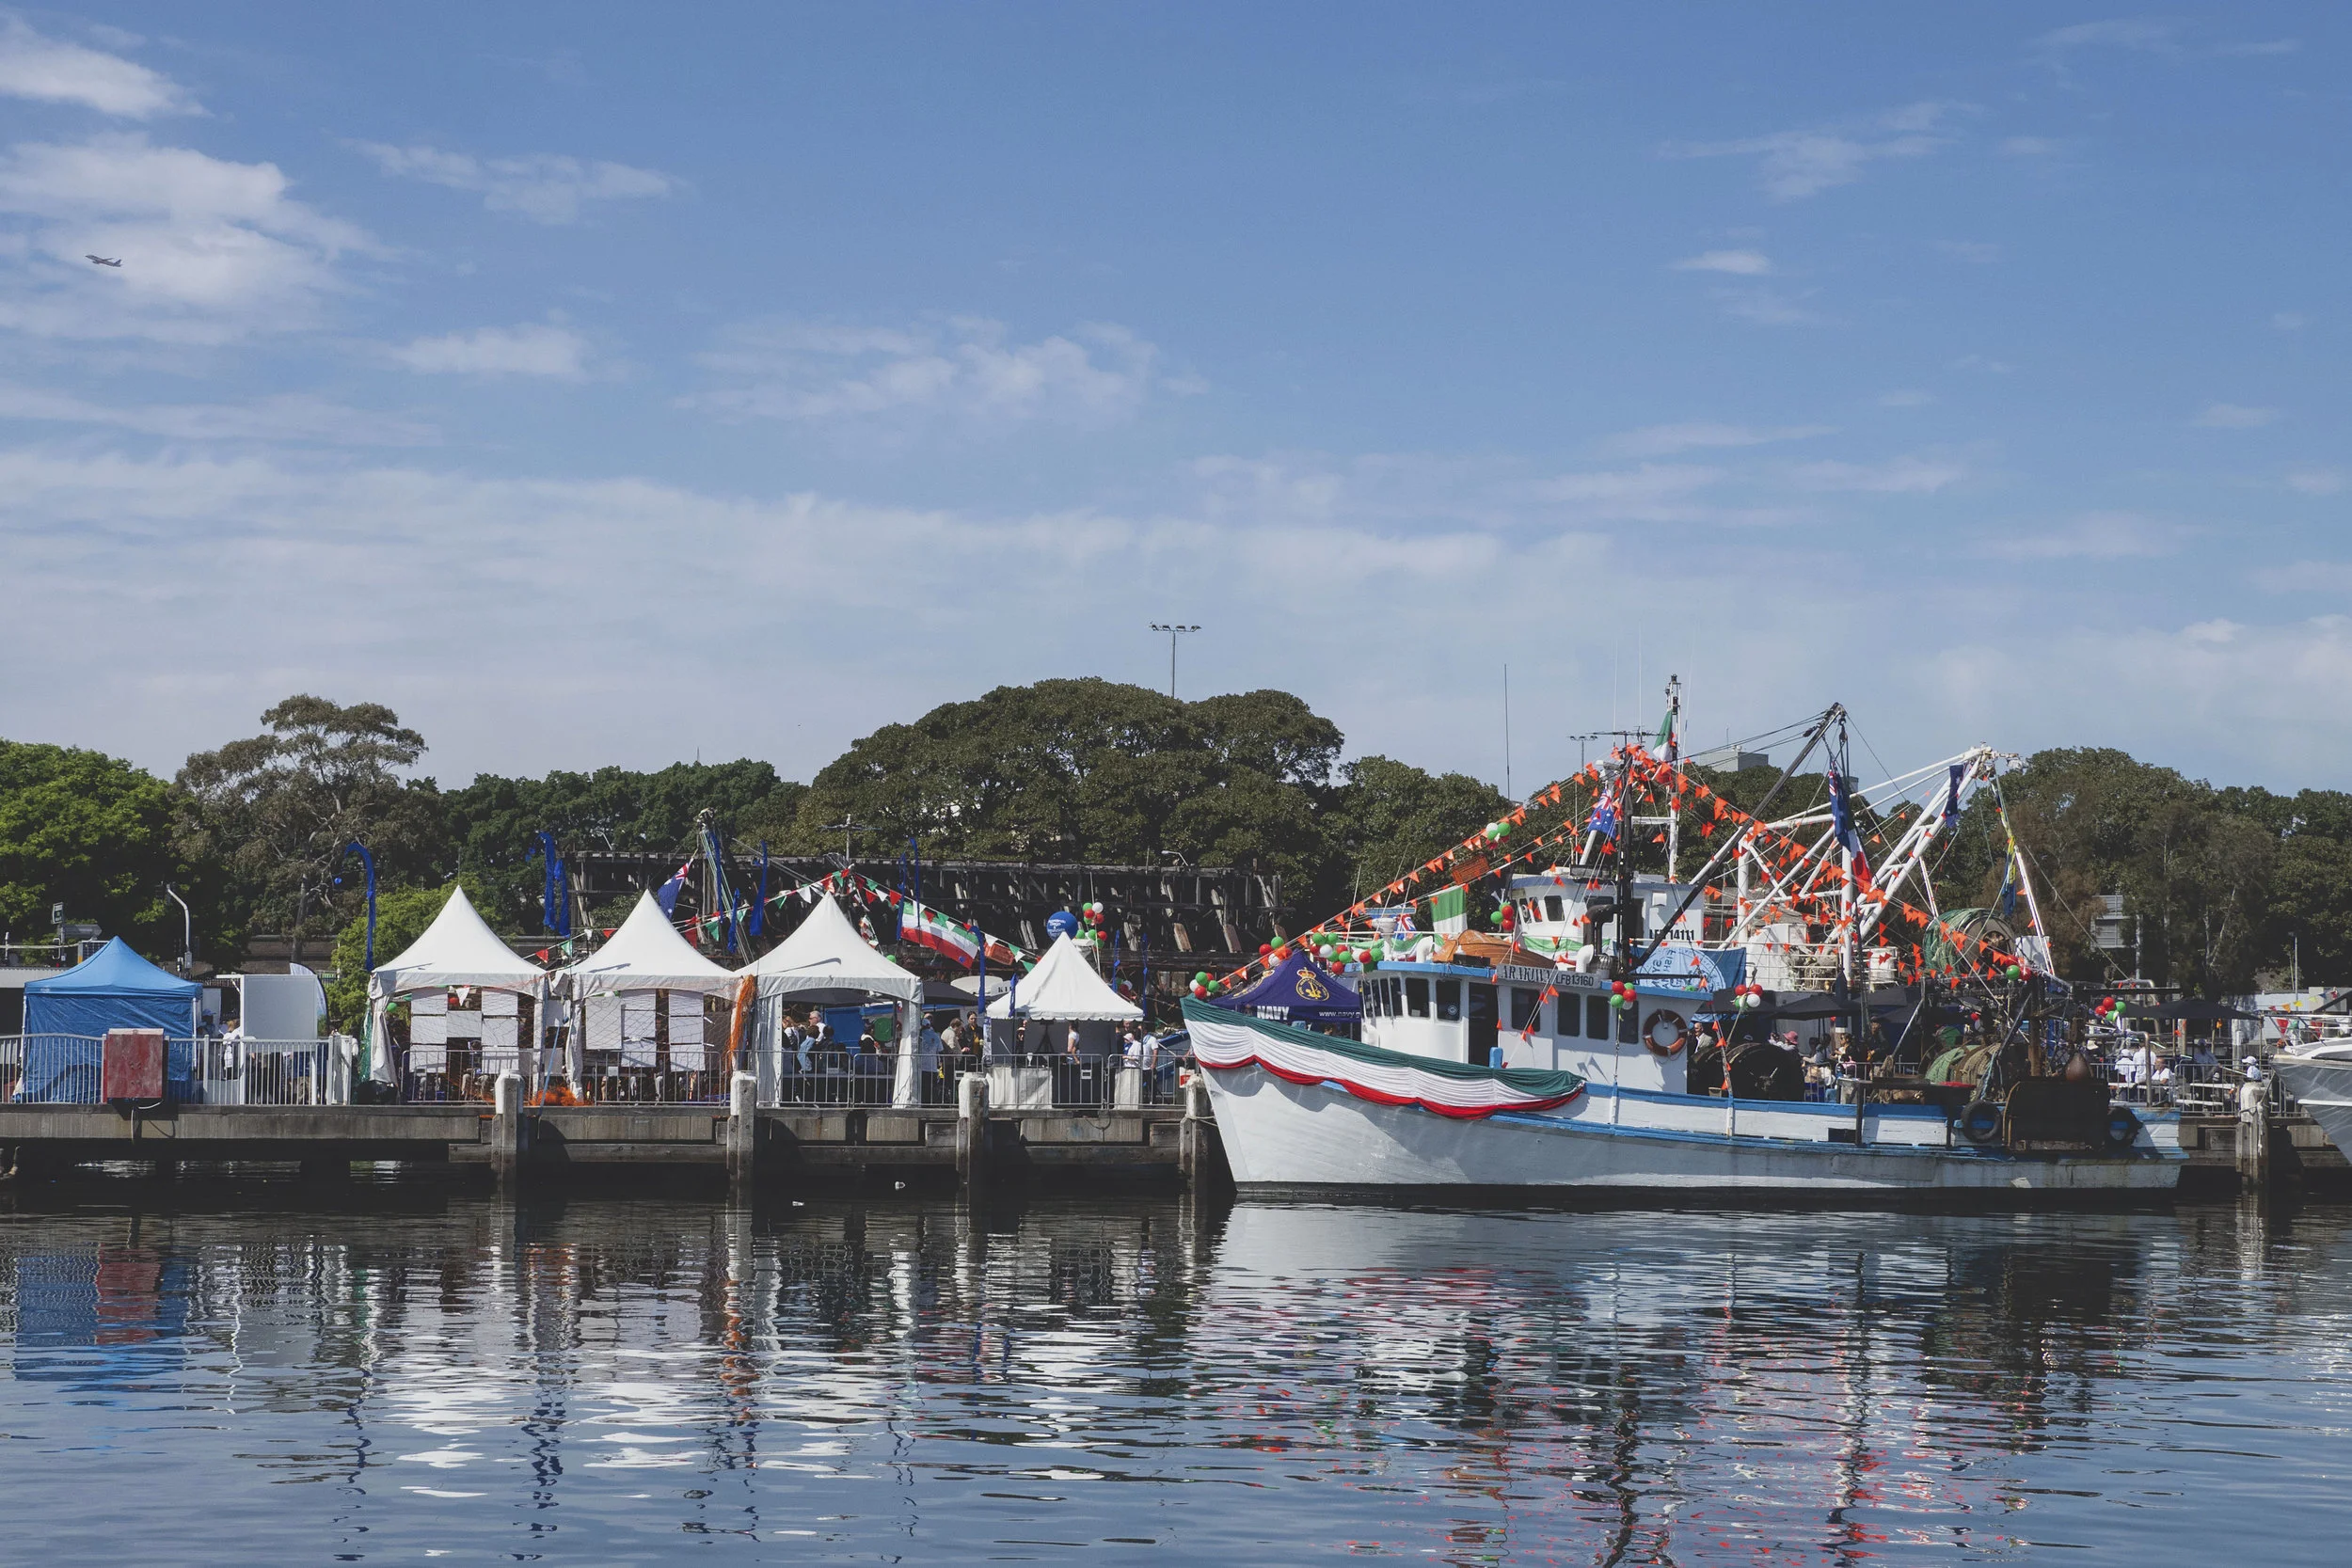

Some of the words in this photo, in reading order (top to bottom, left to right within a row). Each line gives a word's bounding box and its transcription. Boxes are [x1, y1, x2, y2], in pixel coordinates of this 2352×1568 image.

[1669, 929, 1694, 941] 14111
[1556, 973, 1594, 987] LFB13160
[1256, 1005, 1290, 1021] NAVY
